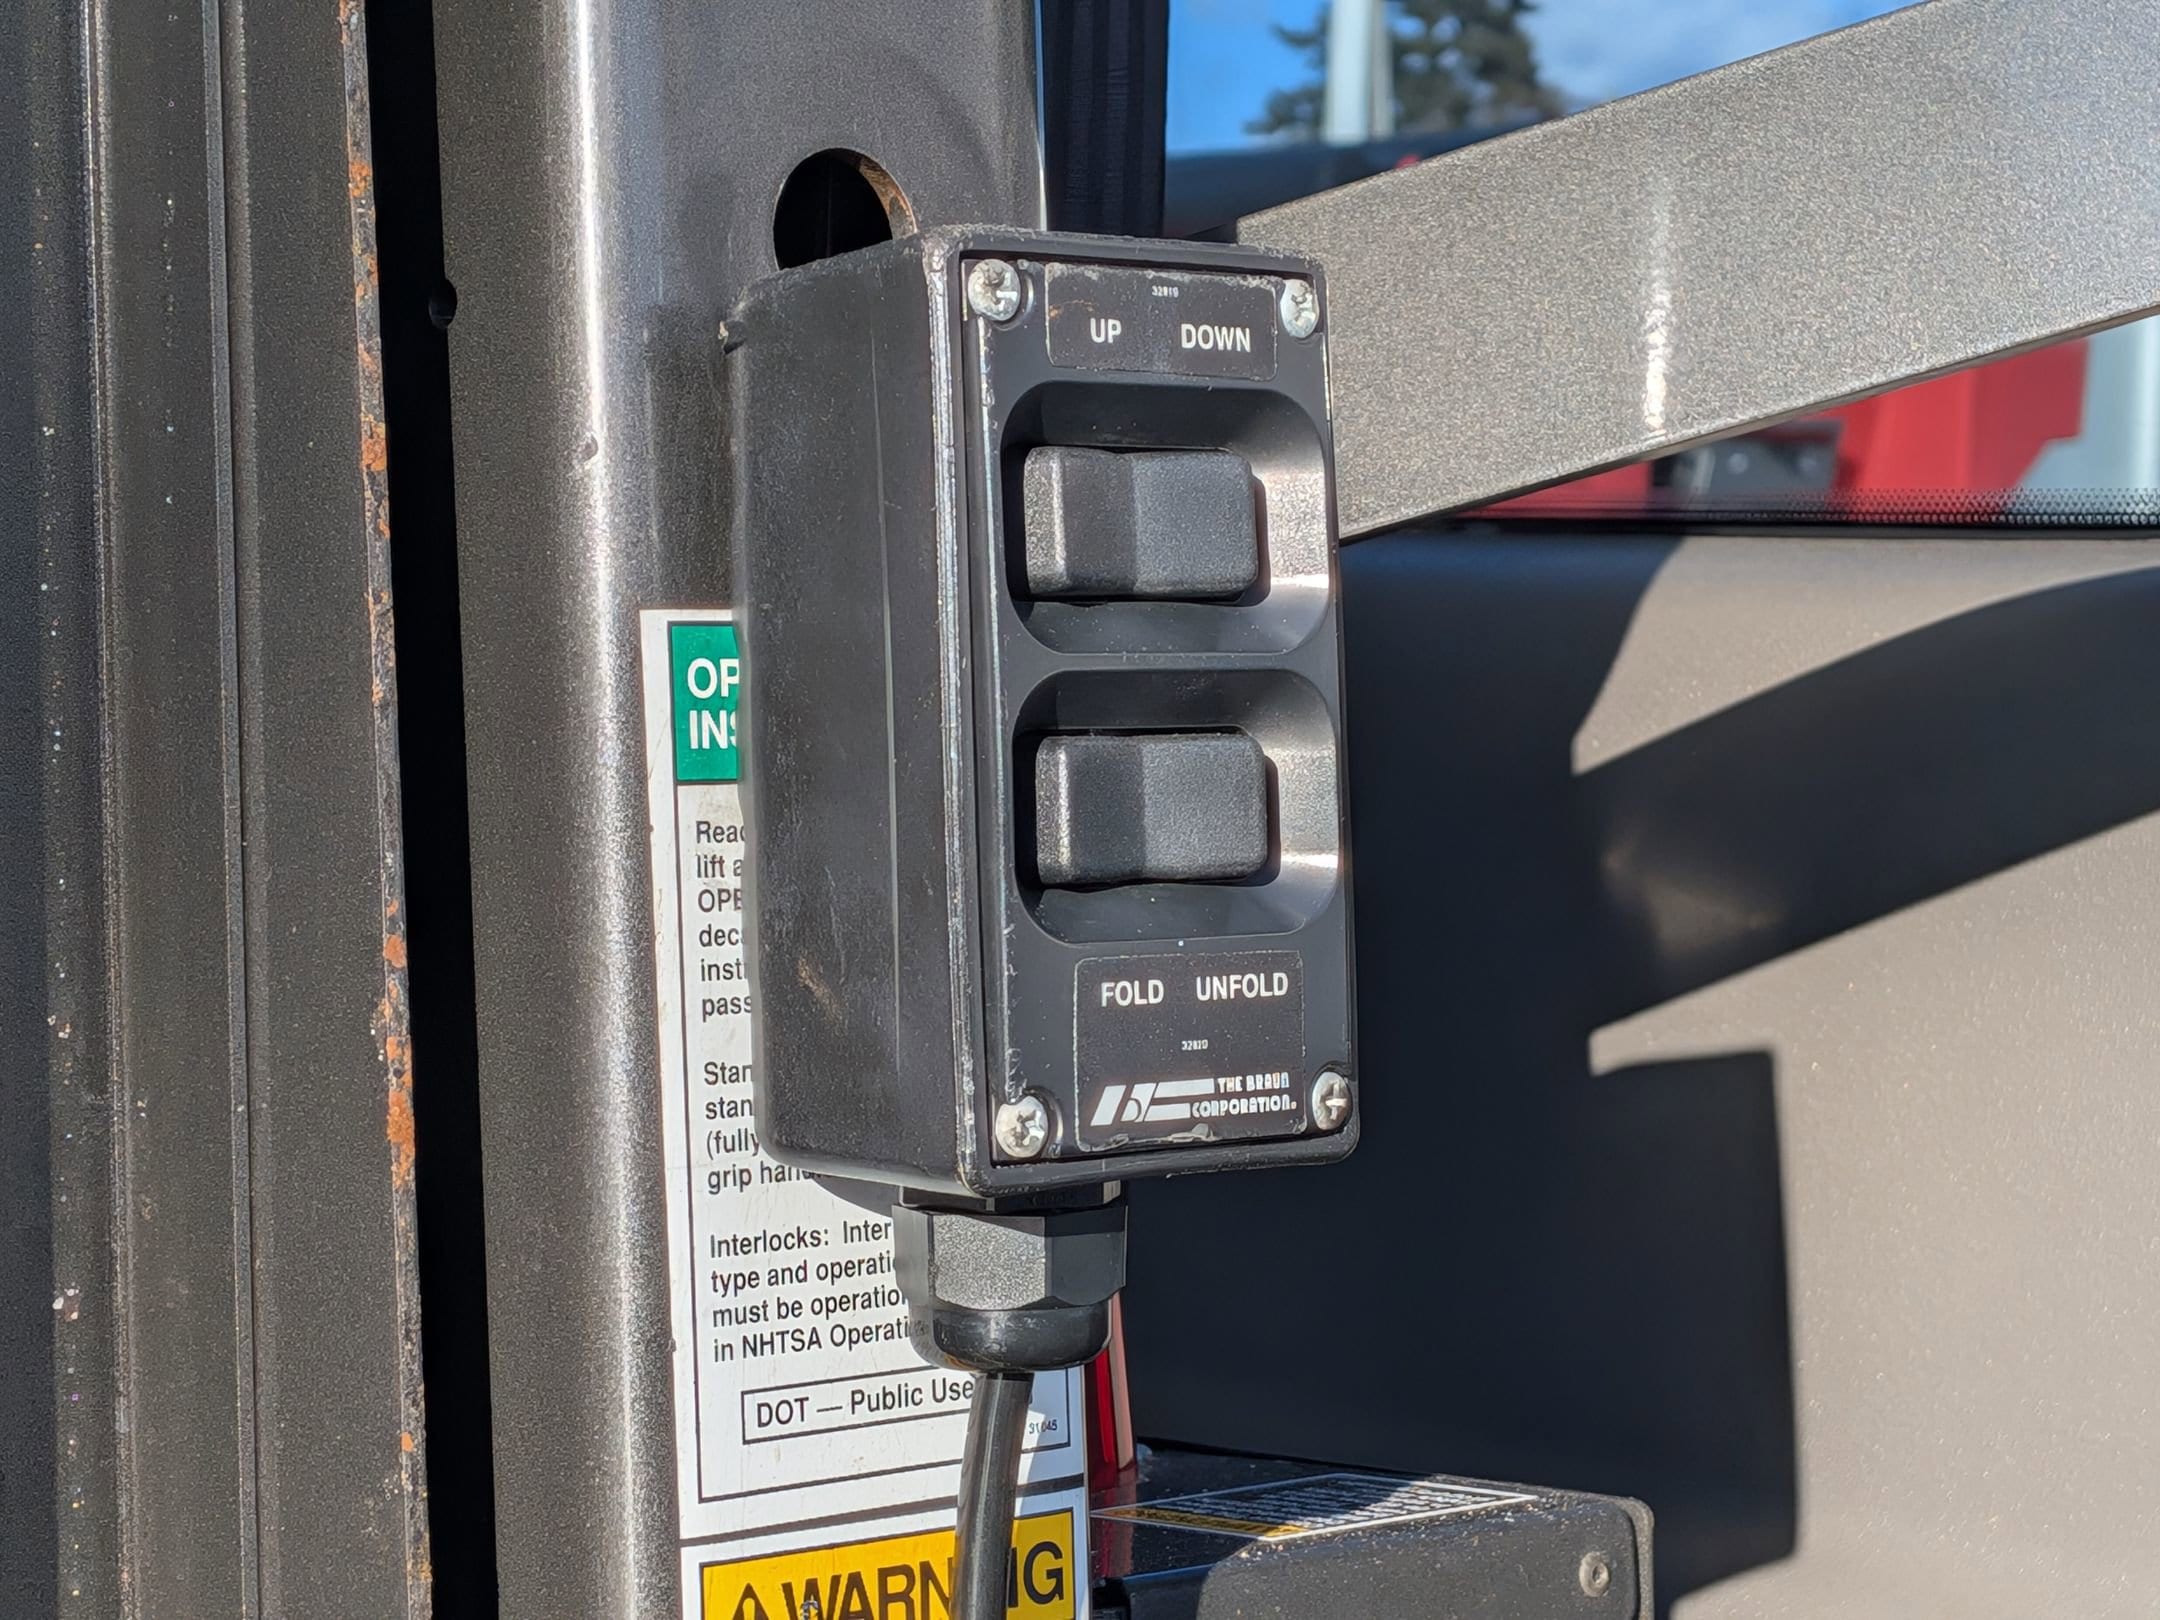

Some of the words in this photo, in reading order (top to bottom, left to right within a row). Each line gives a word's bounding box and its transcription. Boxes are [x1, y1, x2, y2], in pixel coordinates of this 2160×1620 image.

[1090, 318, 1122, 343] UP
[1181, 324, 1251, 352] DOWN
[695, 854, 725, 878] lift
[699, 923, 744, 947] dec
[1101, 980, 1165, 1008] FOLD
[1196, 972, 1289, 1001] UNFOLD
[1217, 1075, 1243, 1094] THE
[707, 1164, 752, 1195] grip
[710, 1227, 829, 1258] Interlocks:
[843, 1218, 893, 1244] Inter
[711, 1270, 760, 1298] type
[767, 1260, 808, 1287] and
[816, 1250, 896, 1286] operati
[713, 1300, 769, 1328] must
[777, 1296, 803, 1319] be
[811, 1284, 906, 1320] operatio
[714, 1338, 734, 1363] in
[743, 1327, 823, 1360] NHTSA
[757, 1396, 809, 1428] DOT
[851, 1382, 923, 1416] Public
[932, 1376, 974, 1403] Use
[781, 1541, 1065, 1620] WARNG
